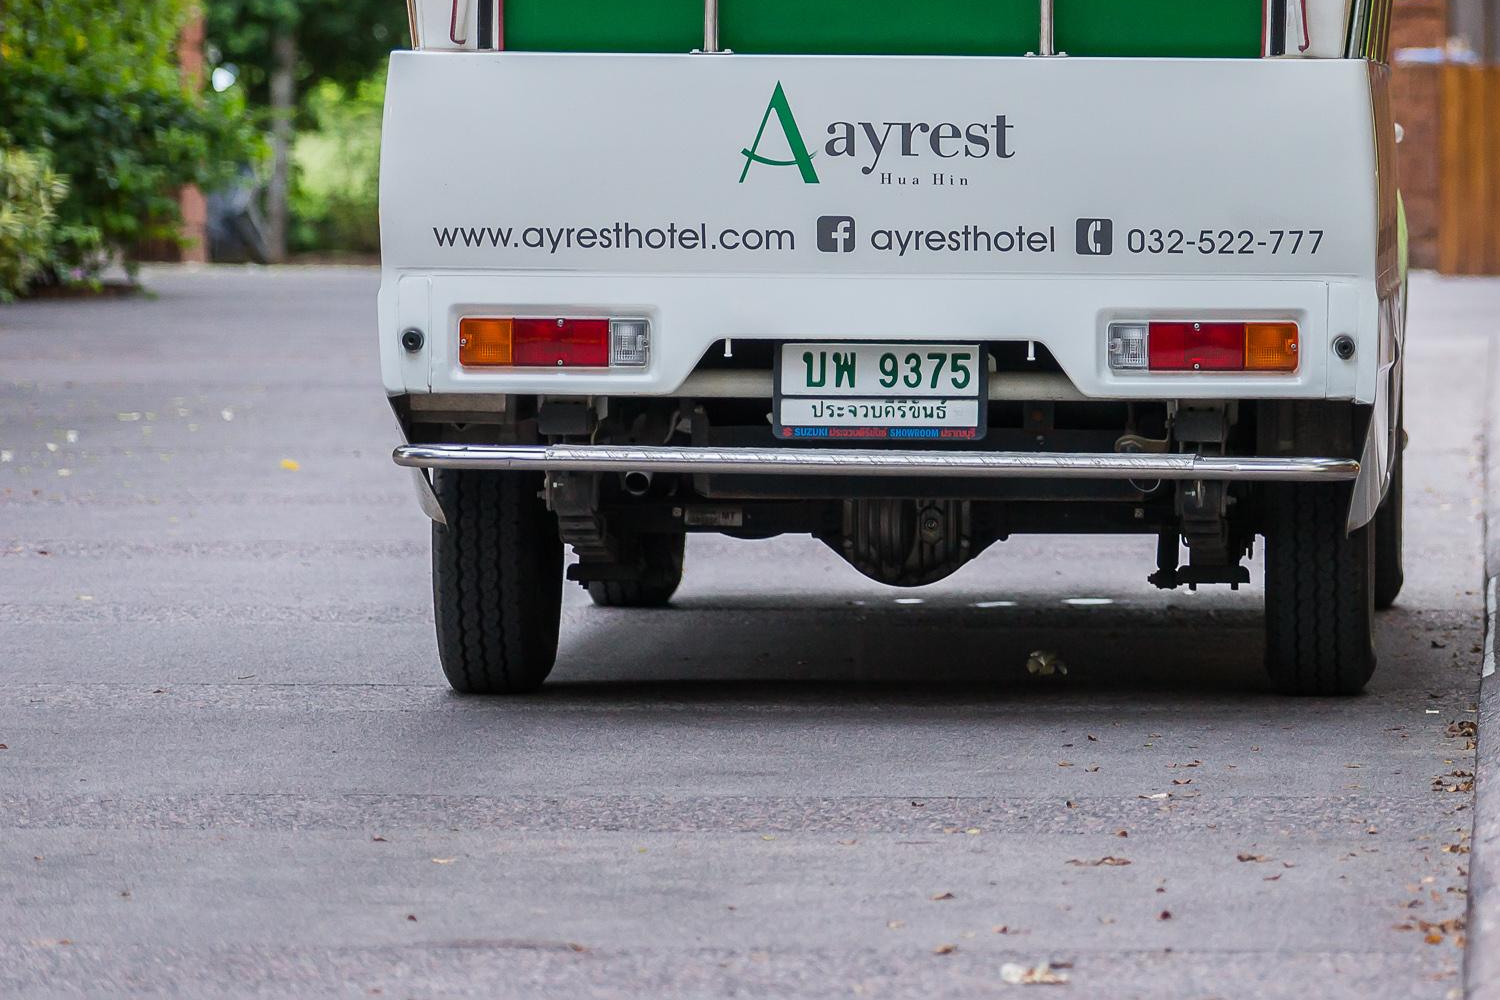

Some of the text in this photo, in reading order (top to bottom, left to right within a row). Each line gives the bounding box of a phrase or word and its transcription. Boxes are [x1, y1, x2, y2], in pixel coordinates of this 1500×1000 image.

[880, 172, 969, 186] Hua Hin
[432, 221, 796, 254] www.ayresthotel.com
[870, 224, 1056, 256] ayresthotel
[1127, 228, 1325, 255] 032-522-777
[802, 351, 972, 389] บพ 9375
[794, 427, 828, 438] SUZUKI
[889, 427, 939, 438] SHOWROOM
